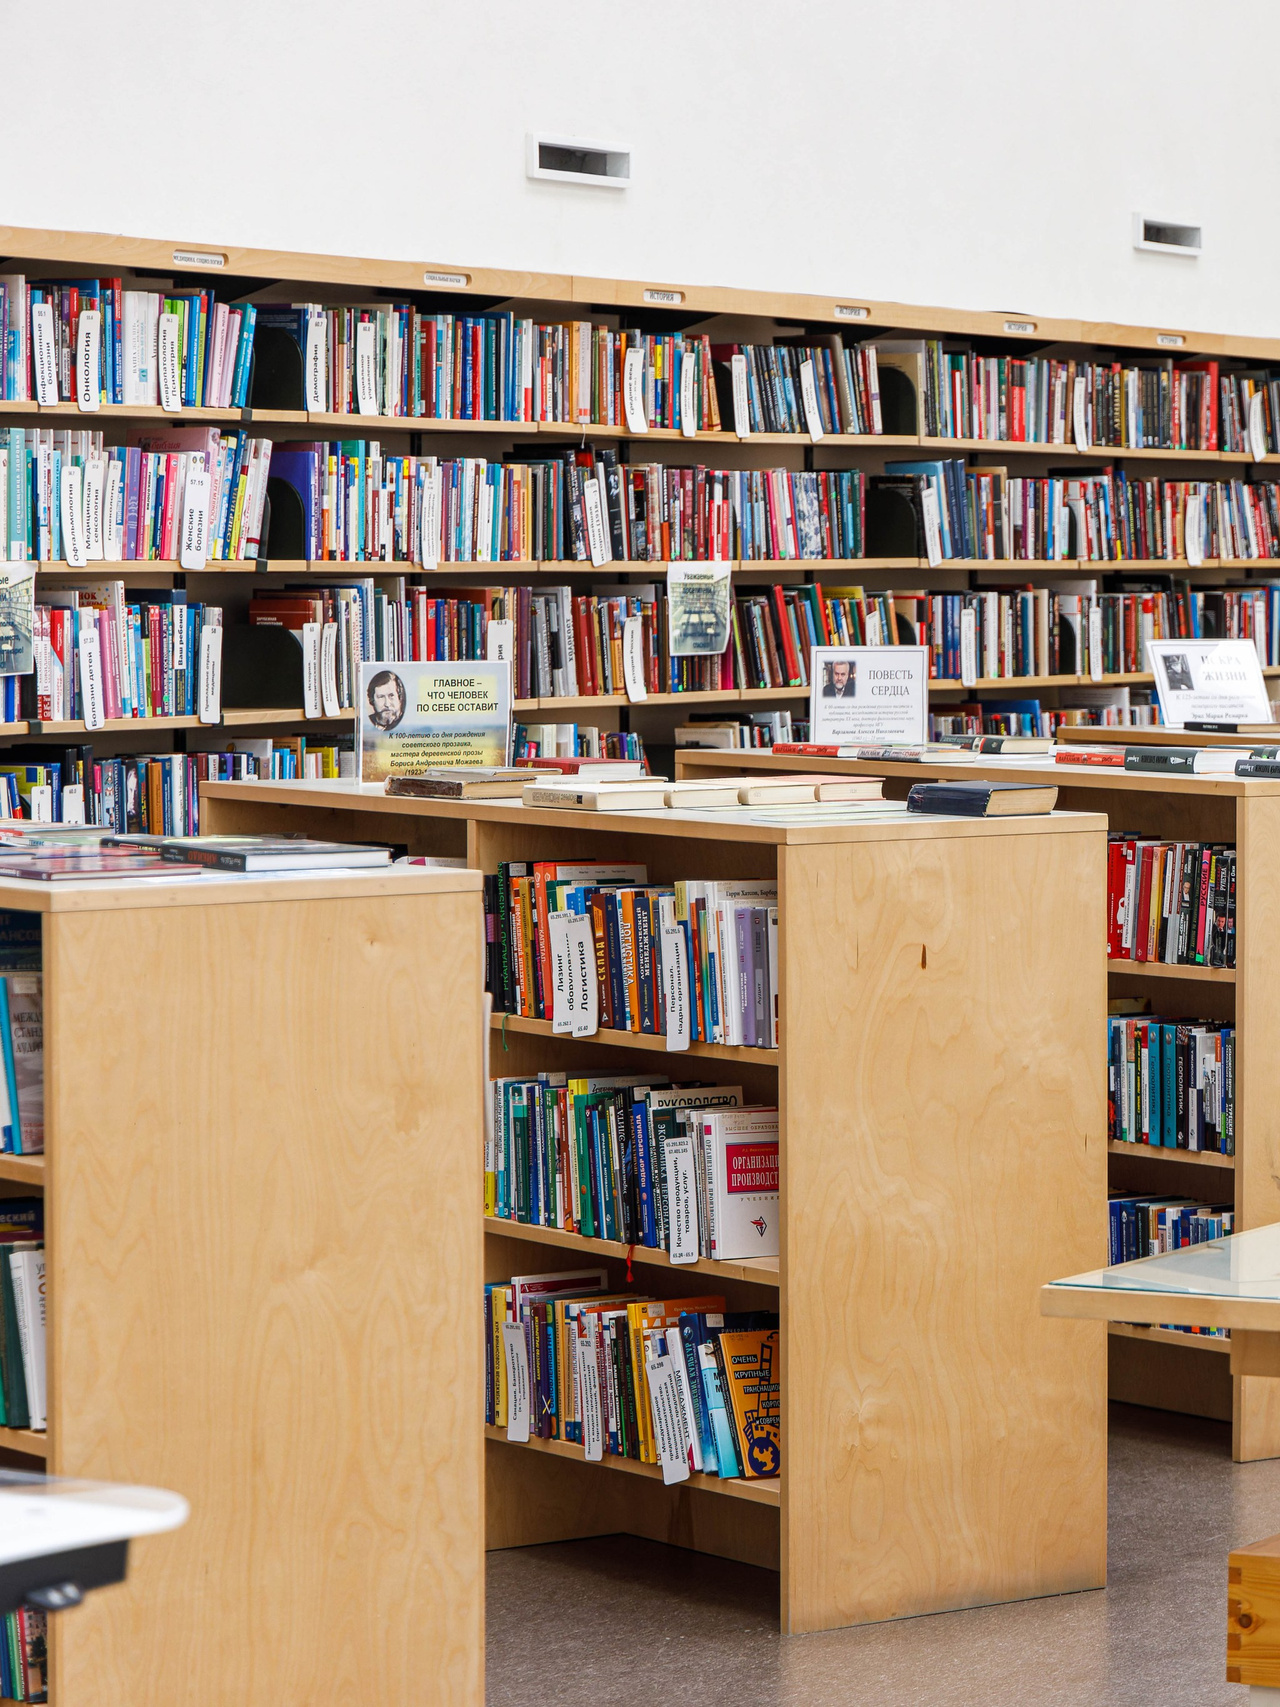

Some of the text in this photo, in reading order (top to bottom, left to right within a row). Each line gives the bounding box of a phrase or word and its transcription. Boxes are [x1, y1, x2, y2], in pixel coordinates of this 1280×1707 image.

[649, 291, 674, 301] ИСТОРИЯ
[38, 323, 47, 403] Инфекционные
[162, 329, 170, 407] Невропатология
[69, 483, 78, 562] Офтальмология
[186, 508, 195, 550] Женские
[683, 571, 714, 580] Уважаемые
[427, 690, 488, 699] ЧТО ЧЕЛОВЕК
[433, 679, 475, 687] ГЛАВНОЕ
[868, 669, 913, 680] ПОВЕСТЬ
[871, 685, 910, 697] СЕРДЦА
[89, 684, 97, 727] Болезни
[416, 702, 498, 712] ПО СЕБЕ ОСТАВИТ
[454, 731, 485, 739] рождения
[416, 759, 454, 767] Андреевича
[1200, 868, 1208, 907] РУССКИЕ
[596, 941, 606, 981] СКЛАД
[623, 923, 634, 985] ЛОГИСТИКА
[636, 907, 645, 980] ЛОГИСТИЧЕСКИЙ
[642, 910, 650, 977] МЕНЕДЖМЕНТ
[578, 941, 588, 1012] Логистика
[674, 942, 682, 1002] организации
[635, 1114, 645, 1157] ПЕРСОНАЛА
[657, 1124, 670, 1235] ЭКОНОМИКА ПЕРСОНАЛА
[705, 1139, 714, 1185] ОРГАНИЗАЦИЯ
[731, 1171, 779, 1187] ПРОИЗВОДСТ
[732, 1355, 758, 1364] ОЧЕНЬ
[734, 1369, 771, 1379] КРУПНЫЕ
[668, 1373, 680, 1418] предприятий
[675, 1370, 690, 1439] МЕНЕДЖМЕНТ
[685, 1342, 702, 1438] СТОЛКНОВЕНИЕ КУЛЬТУР
[654, 1396, 666, 1453] Международное
[659, 1384, 674, 1461] предпринимательство.
[663, 1382, 679, 1460] Внешнеэкономическая
